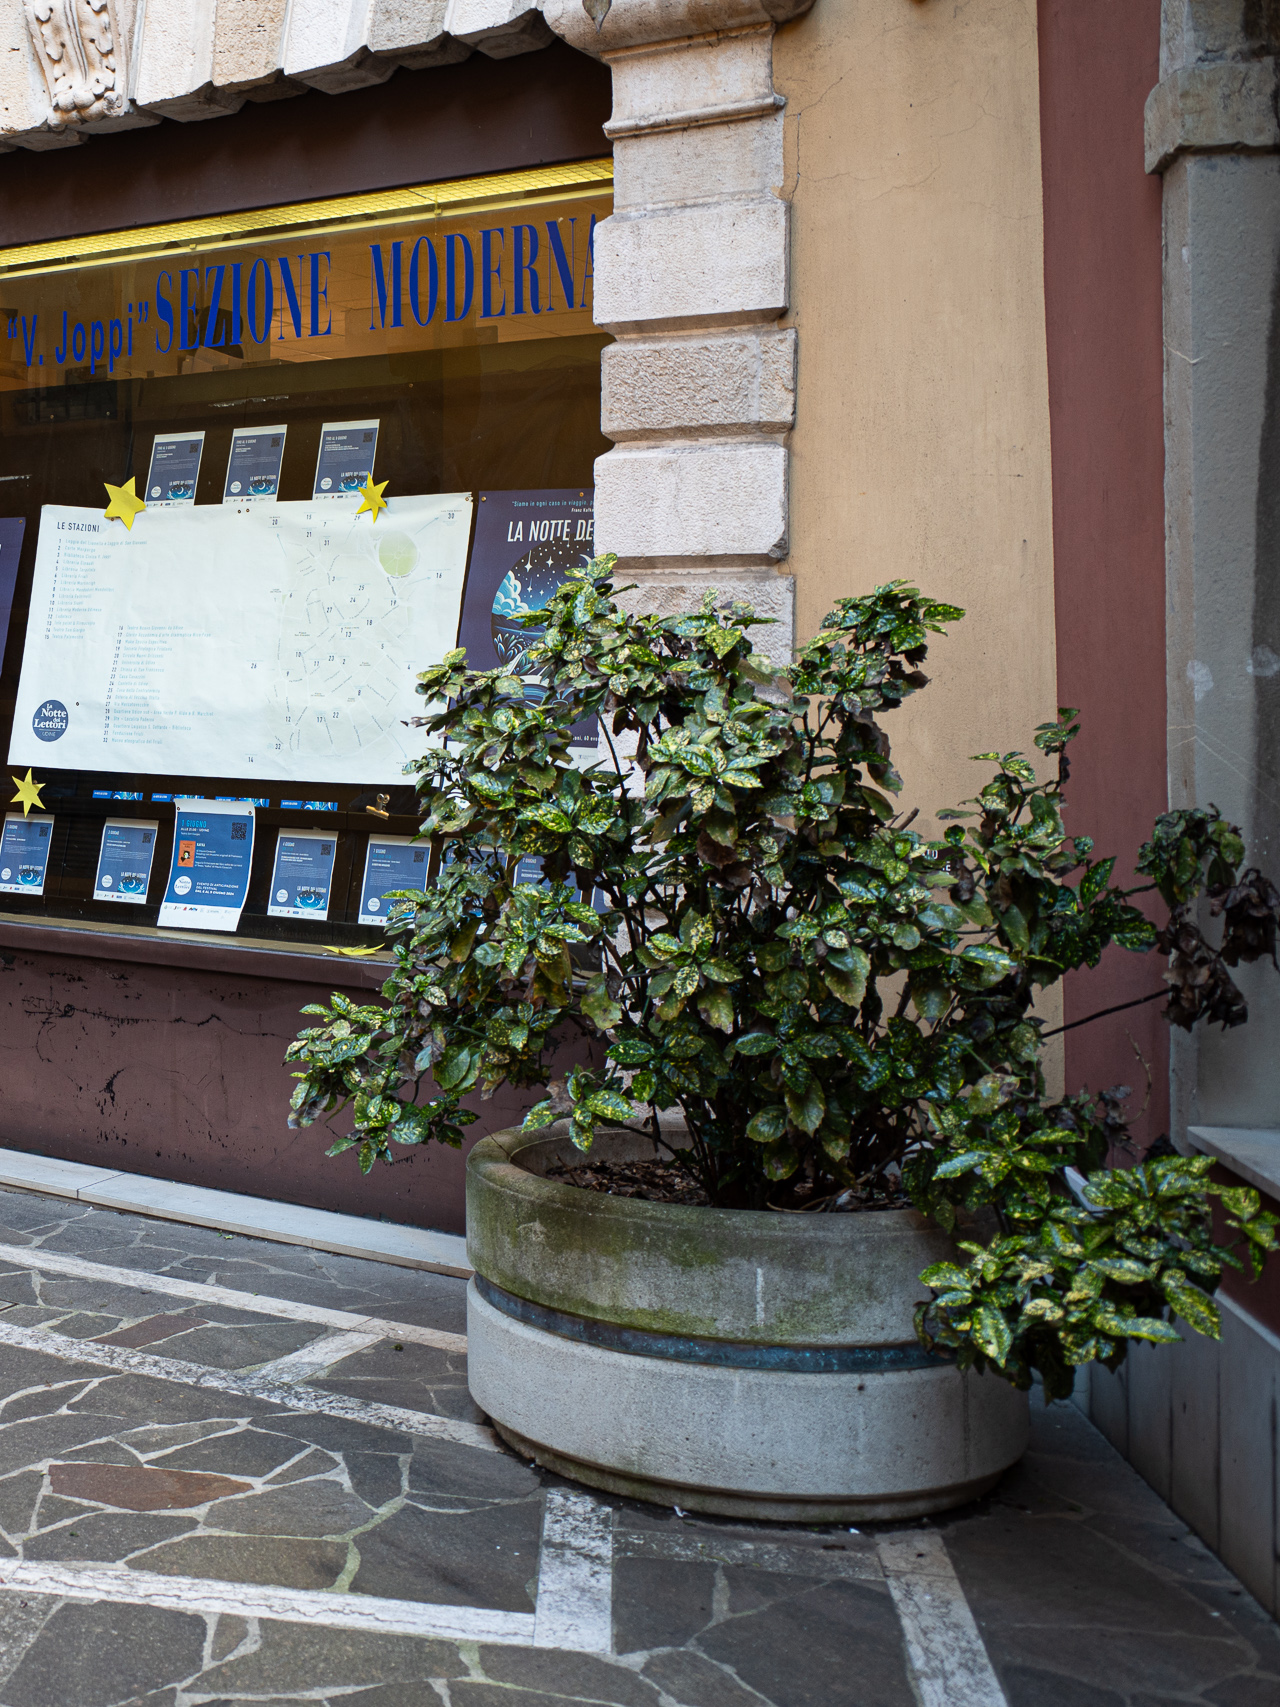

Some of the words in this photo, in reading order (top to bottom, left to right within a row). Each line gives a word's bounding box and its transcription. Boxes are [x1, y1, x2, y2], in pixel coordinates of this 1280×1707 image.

[55, 302, 149, 374] Joppi"
[156, 252, 332, 354] SEZIONE
[57, 522, 65, 530] LE
[68, 523, 100, 533] STAZIONI
[507, 521, 523, 542] LA
[529, 520, 572, 542] NOTTE
[574, 520, 595, 541] DE
[41, 708, 66, 717] Notte
[34, 718, 65, 728] Lettori
[186, 820, 207, 828] GIUGNO
